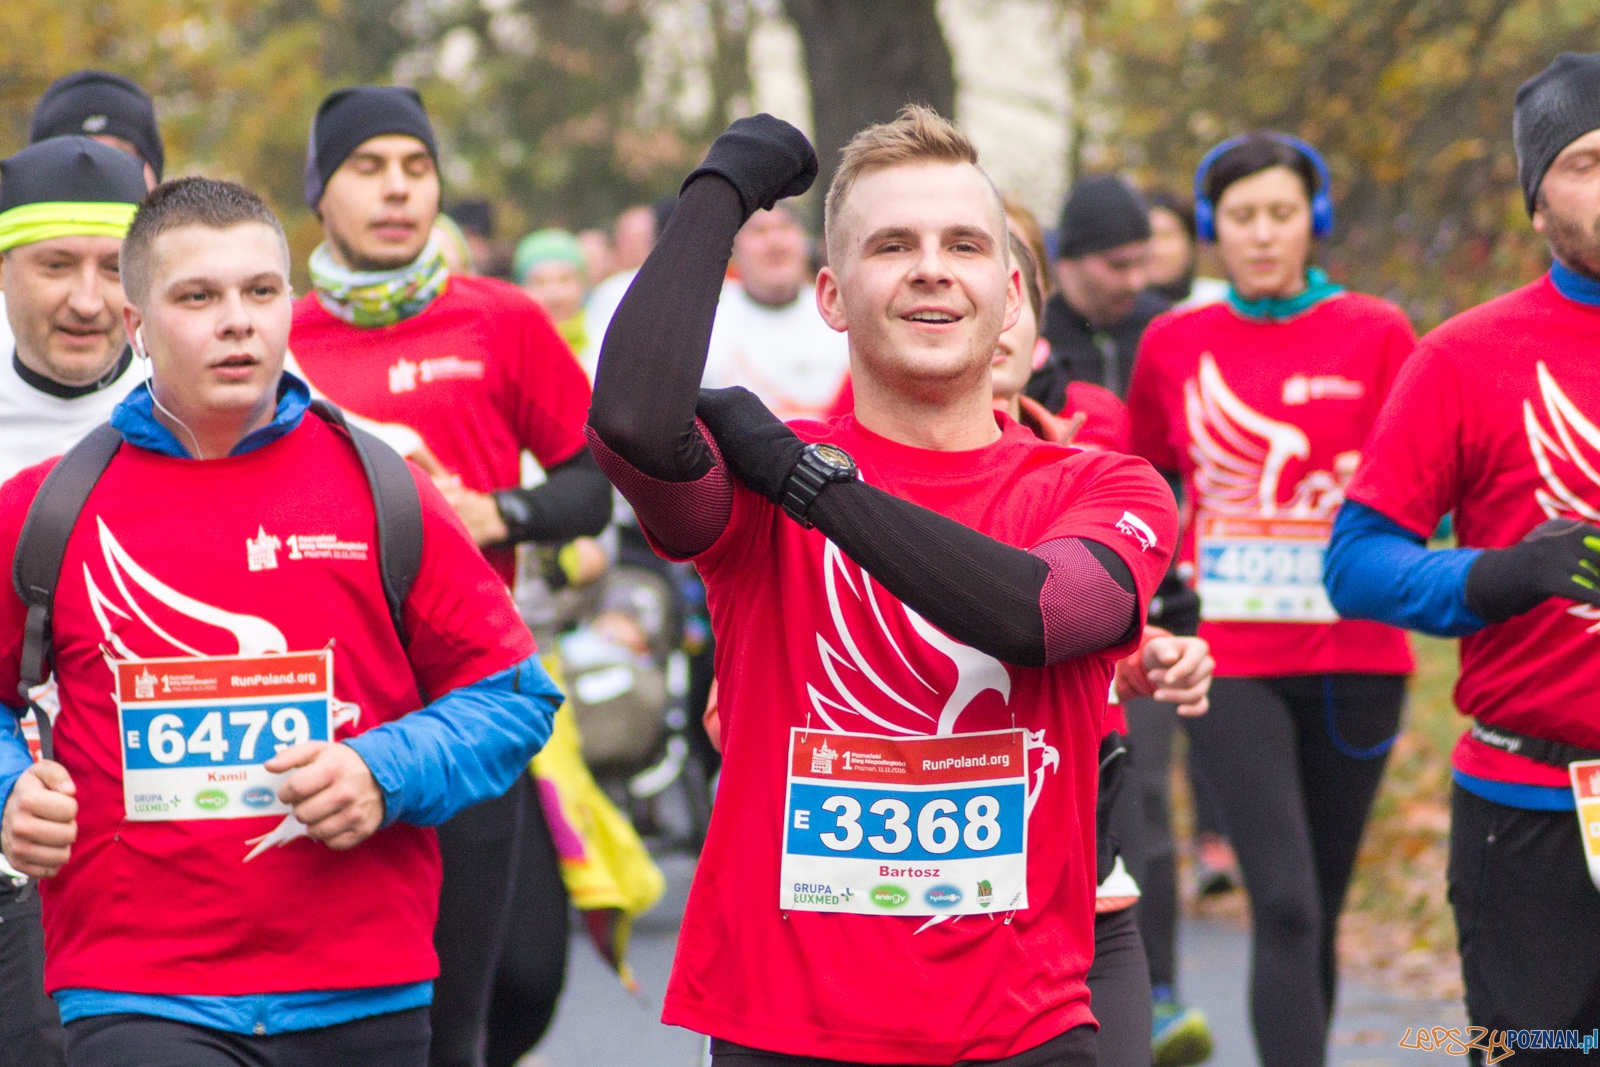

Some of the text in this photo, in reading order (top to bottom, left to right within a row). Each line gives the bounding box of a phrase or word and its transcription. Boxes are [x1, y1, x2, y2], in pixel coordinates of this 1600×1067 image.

[286, 534, 303, 560] 1
[161, 674, 171, 693] 1
[231, 672, 316, 687] RunPoland.org
[127, 708, 310, 764] E 6479
[842, 751, 853, 771] 1
[922, 754, 1010, 771] RunPoland.org
[207, 771, 247, 782] Kamil
[134, 793, 164, 804] GRUPA
[134, 802, 170, 813] LUXMED
[793, 794, 1002, 854] E 3368
[879, 865, 940, 878] Bartosz
[794, 882, 832, 894] GRUPA
[794, 893, 839, 905] LUXMED
[875, 894, 905, 904] energy
